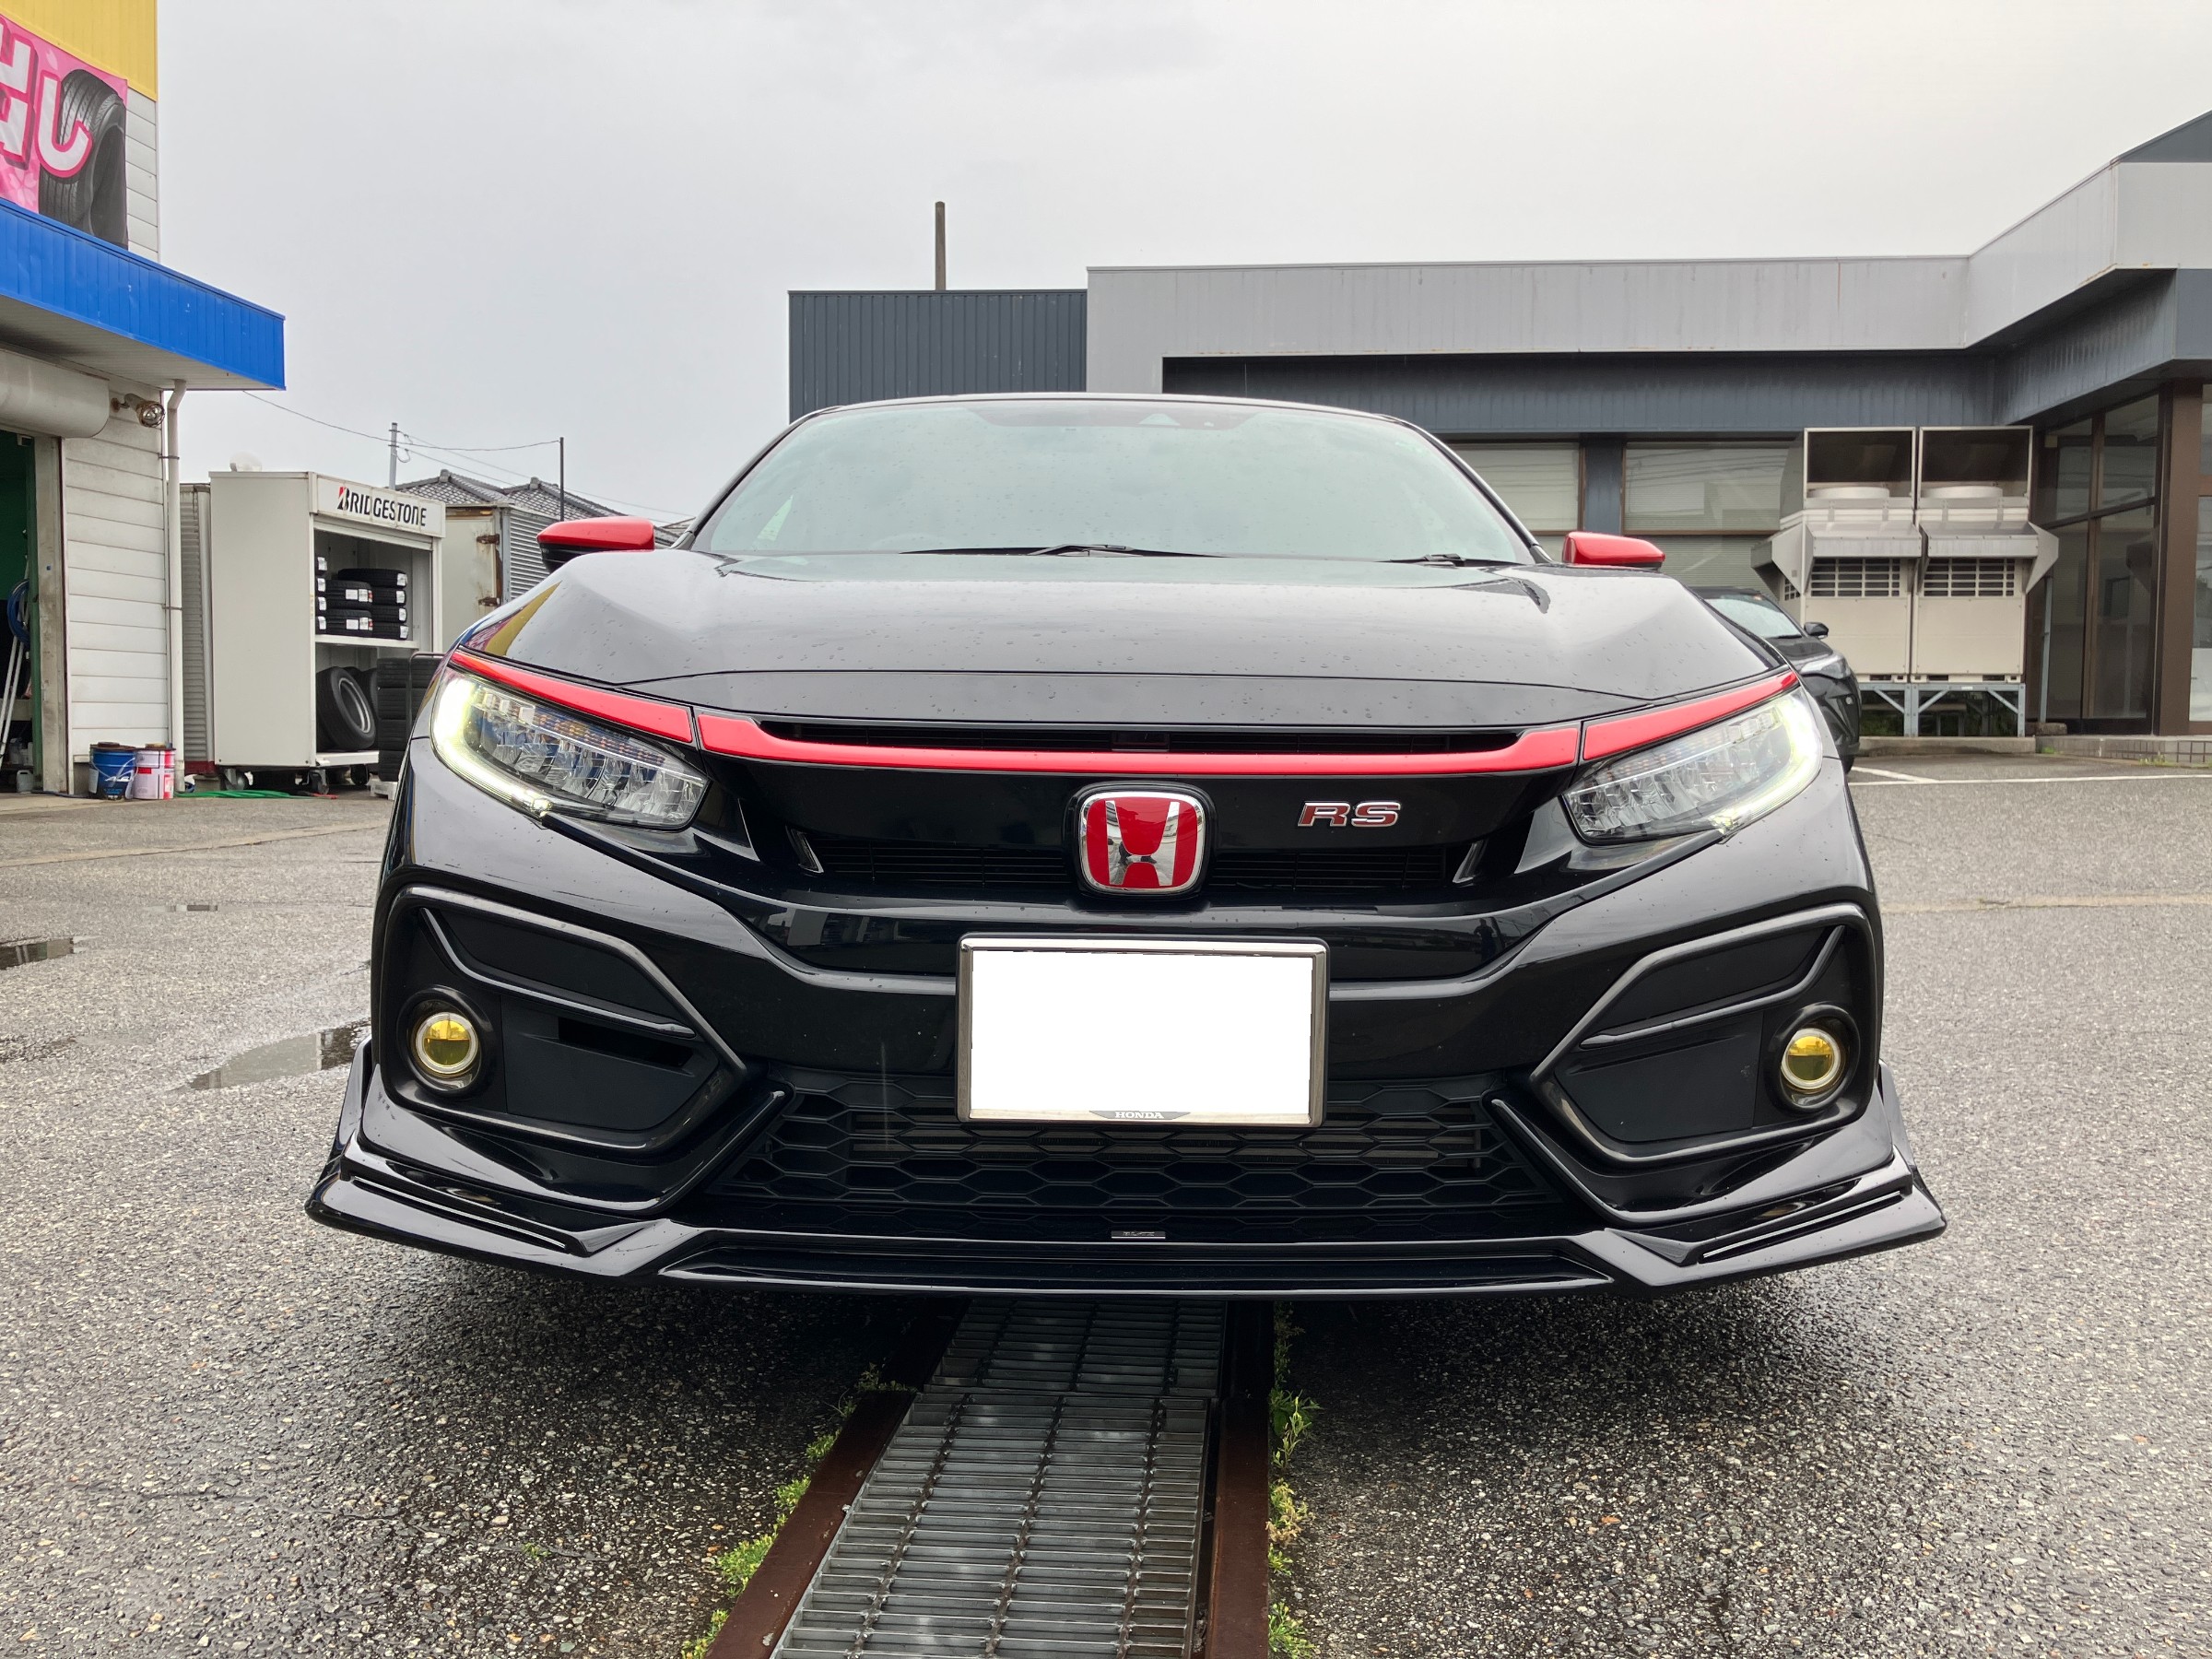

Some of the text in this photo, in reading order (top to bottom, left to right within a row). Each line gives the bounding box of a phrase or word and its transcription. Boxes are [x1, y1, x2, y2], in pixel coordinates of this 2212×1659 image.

[337, 486, 427, 527] BRIDGESTONE
[1298, 800, 1401, 828] RS
[1114, 1111, 1165, 1120] HONDA
